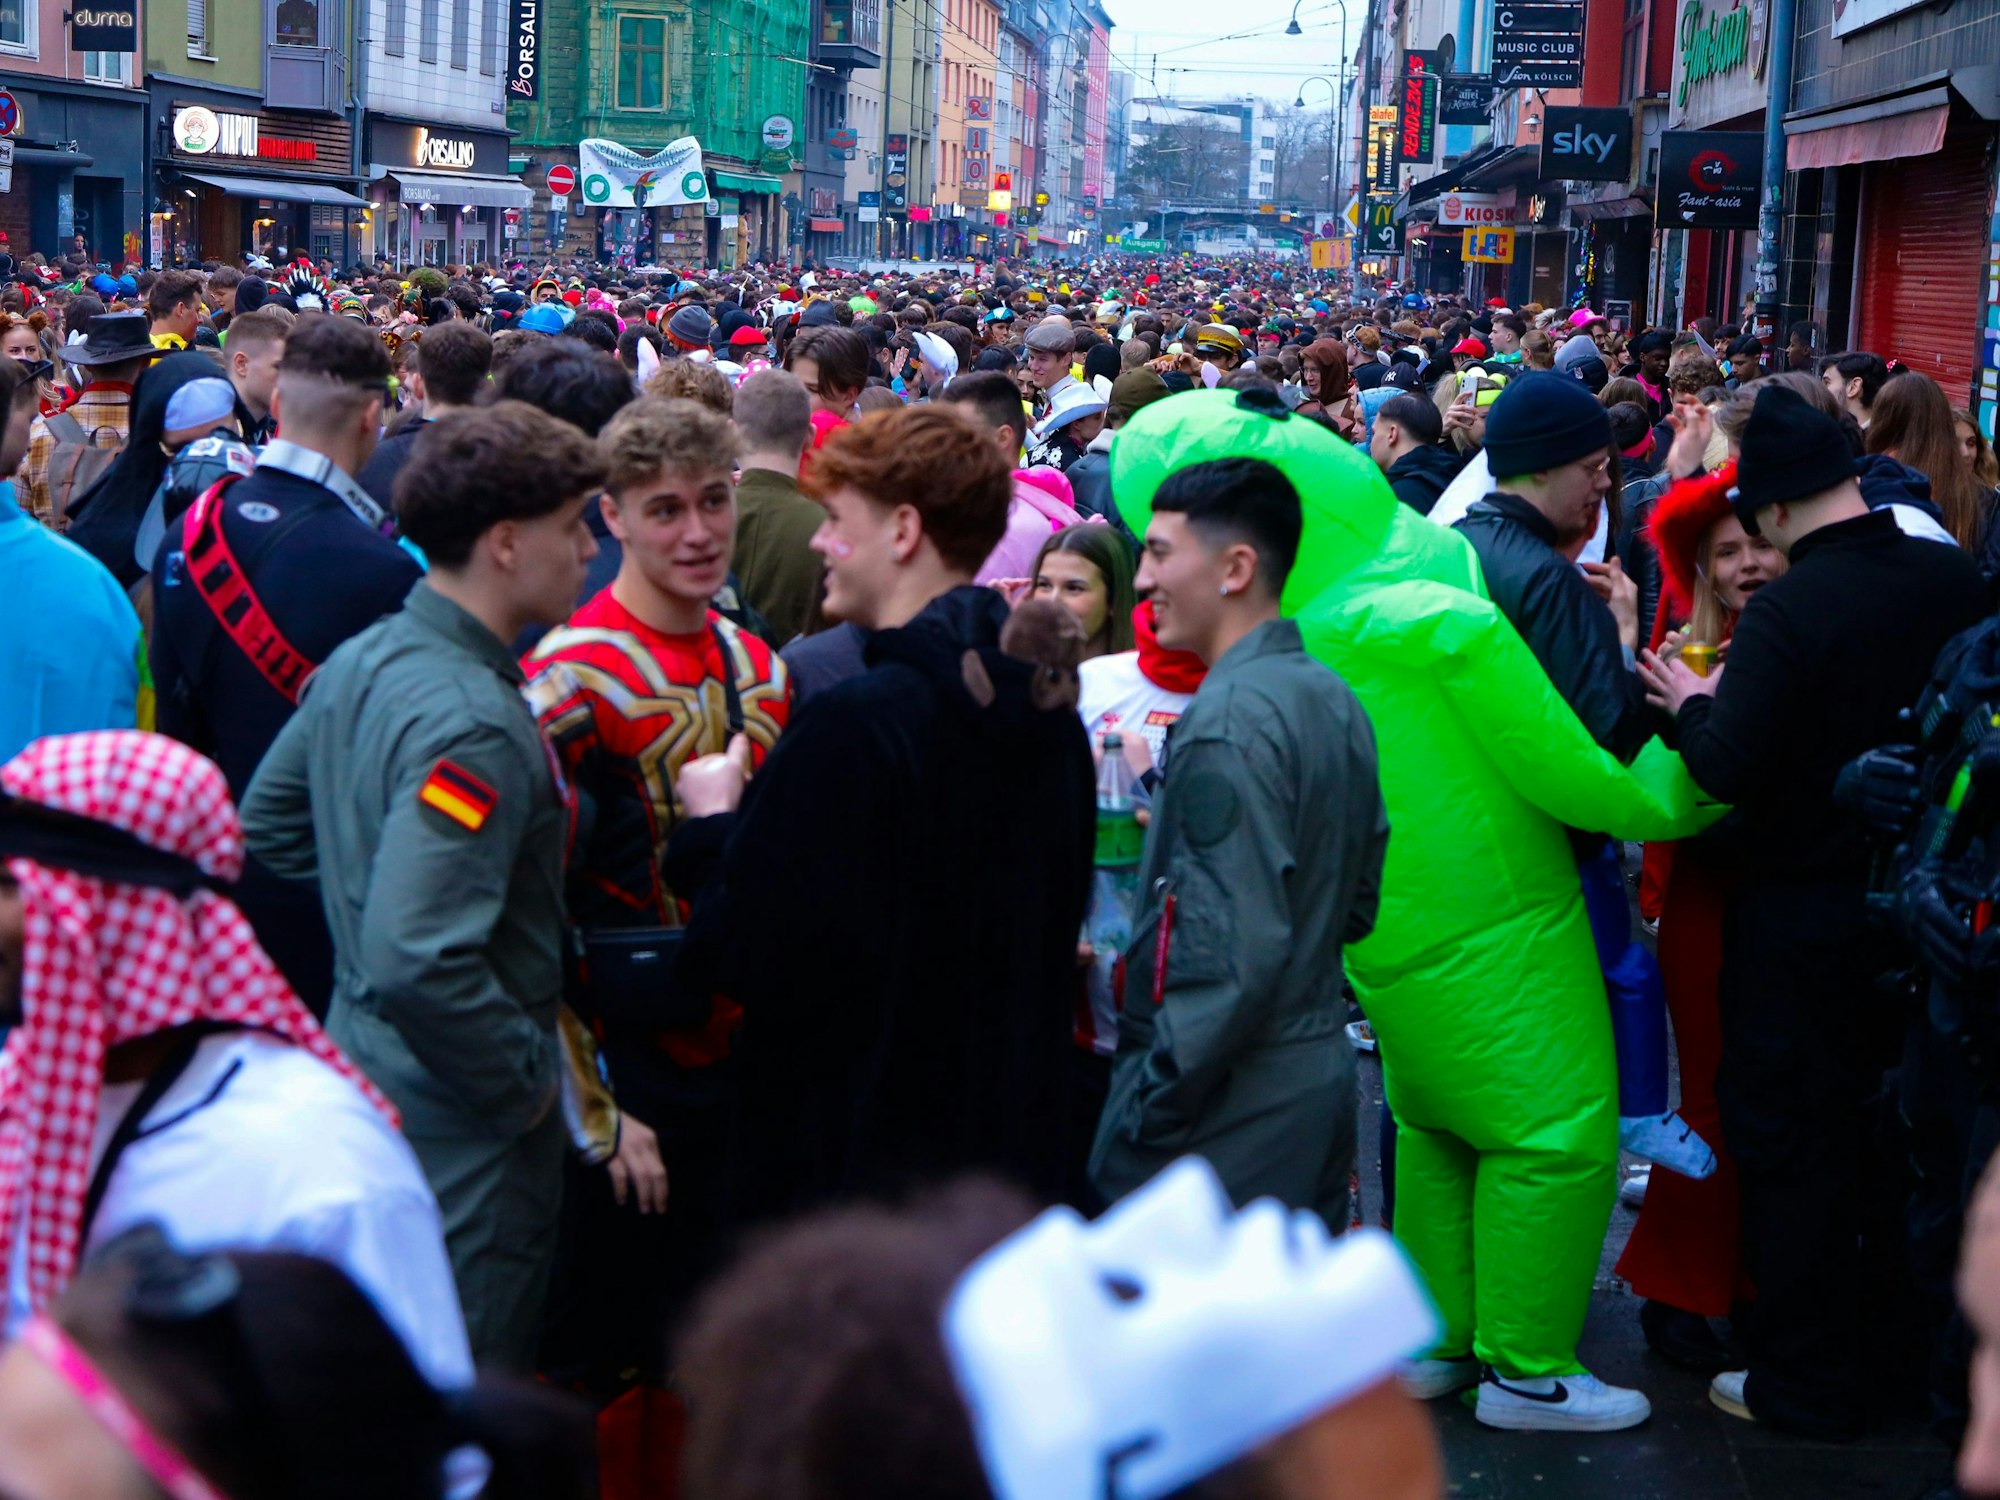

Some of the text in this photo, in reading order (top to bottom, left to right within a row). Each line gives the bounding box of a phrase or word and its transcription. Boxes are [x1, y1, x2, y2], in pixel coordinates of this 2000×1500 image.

[75, 9, 132, 27] duma
[1497, 43, 1575, 53] MUSIC CLUB
[1497, 65, 1572, 84] Sion KÖLSCH
[221, 113, 258, 157] NAPOLI
[1552, 123, 1617, 163] sky
[416, 127, 475, 168] BORSALINO
[1678, 192, 1742, 208] Fant-asia
[1465, 208, 1515, 221] KIOSK
[1125, 239, 1161, 249] Ausgang
